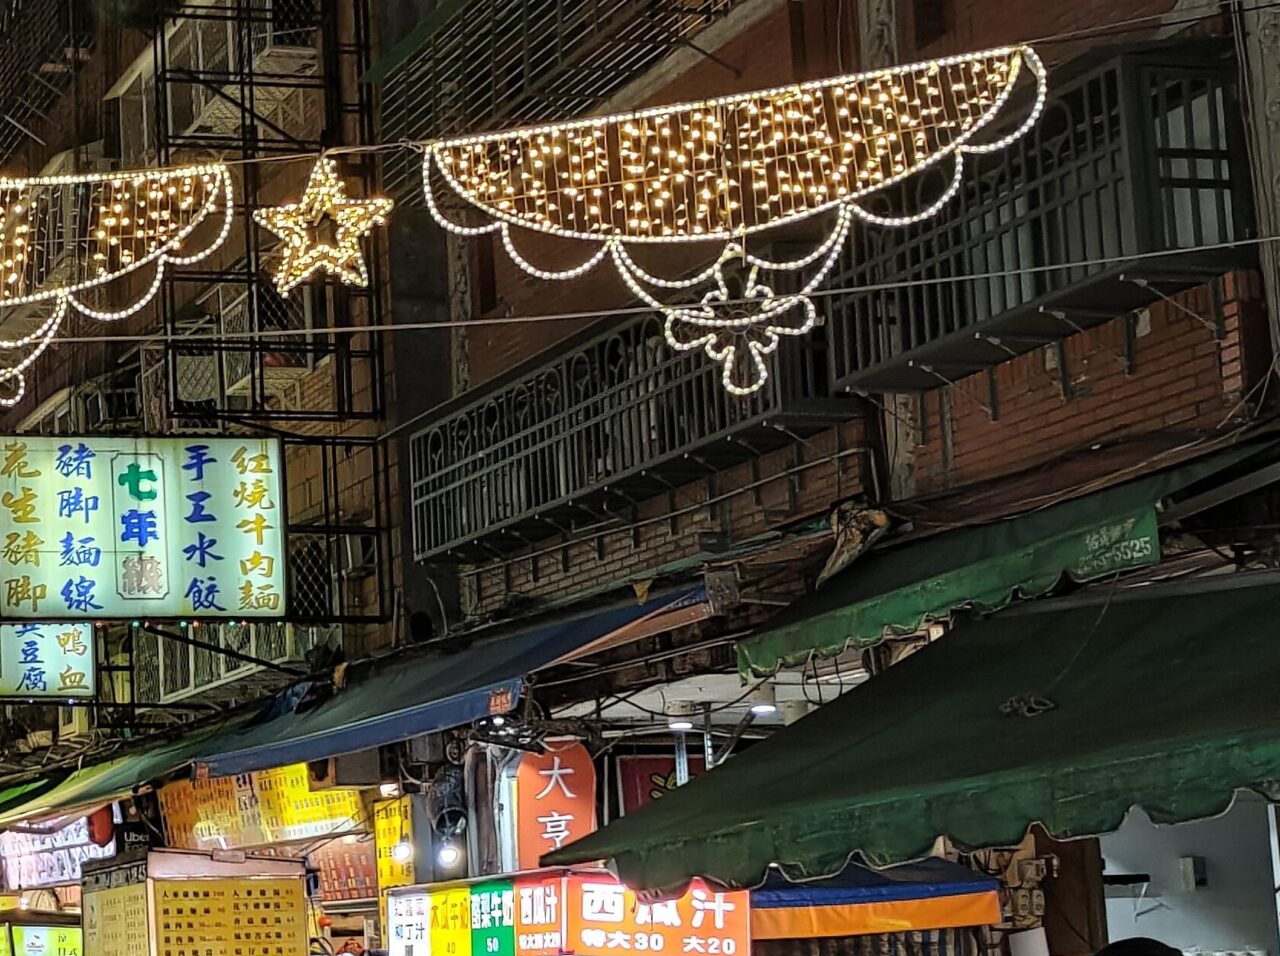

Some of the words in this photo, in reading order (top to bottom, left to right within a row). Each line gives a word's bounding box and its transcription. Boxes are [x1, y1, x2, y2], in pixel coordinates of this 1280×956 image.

[118, 462, 161, 595] 七年級
[181, 444, 227, 613] 手工水餃
[581, 883, 736, 930] 西瓜汁
[682, 935, 737, 956] 大20
